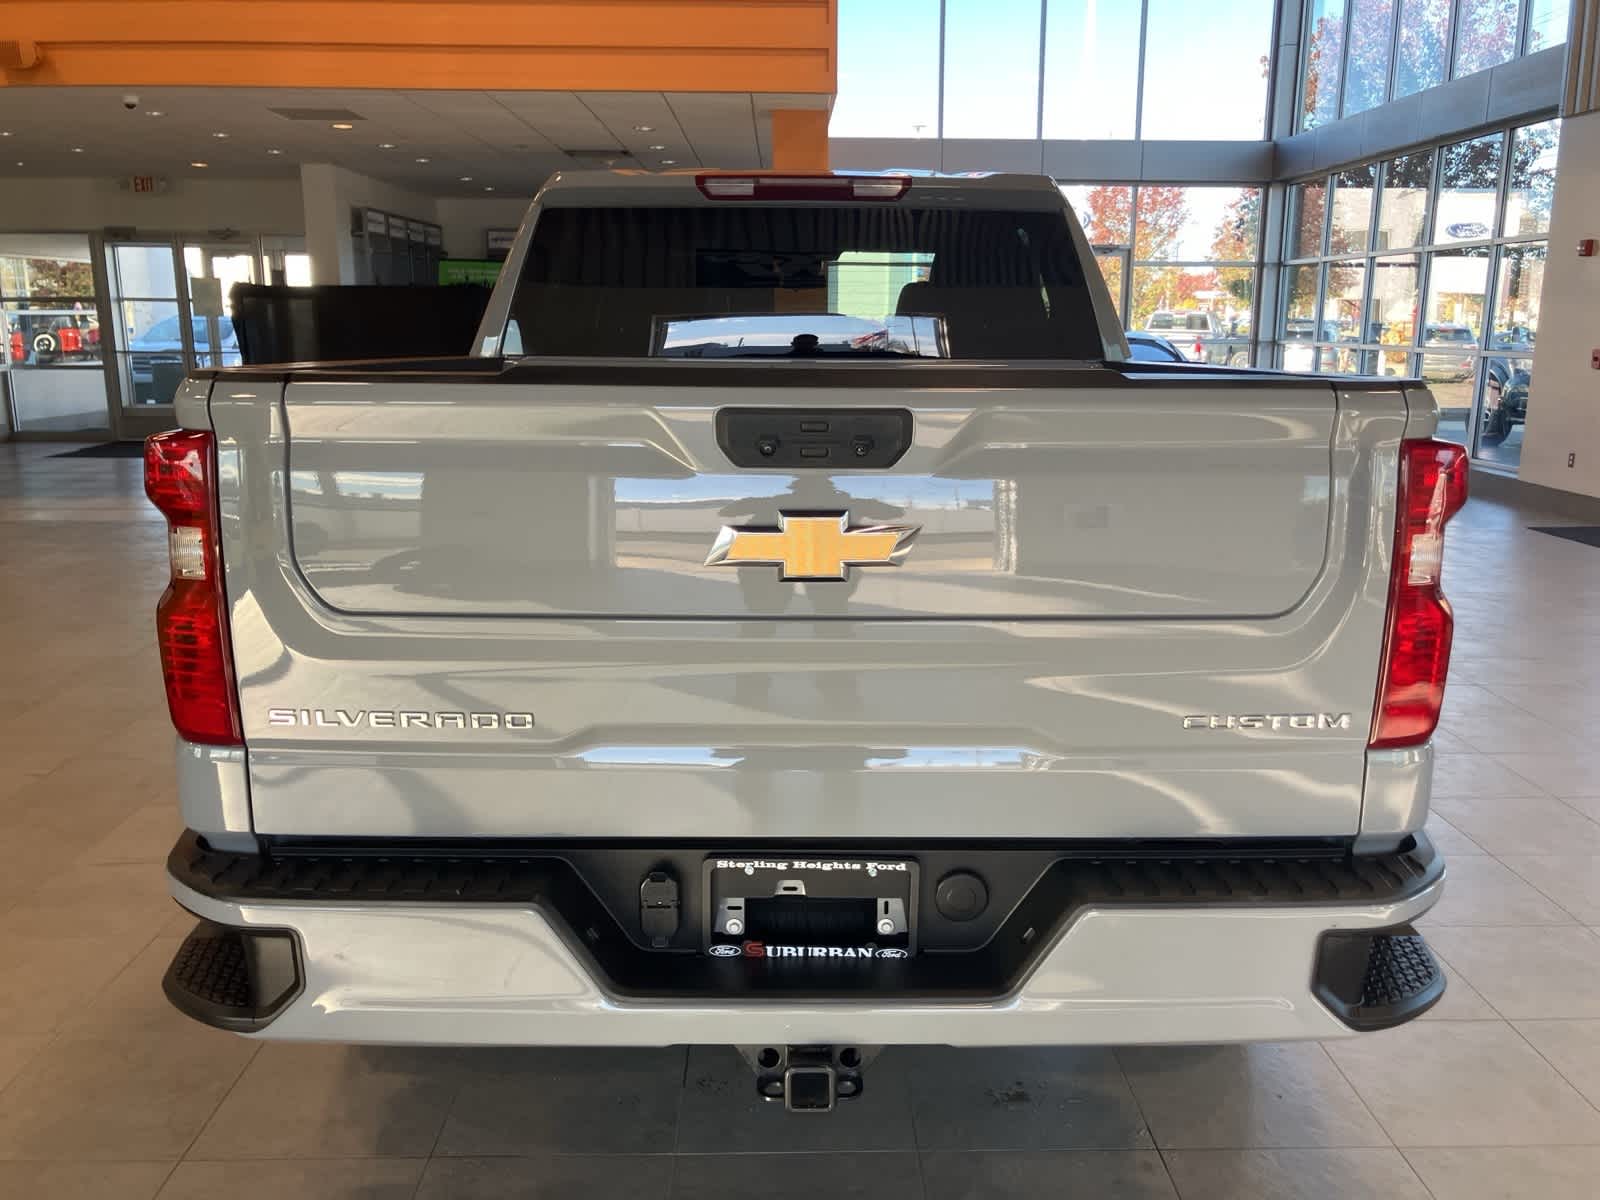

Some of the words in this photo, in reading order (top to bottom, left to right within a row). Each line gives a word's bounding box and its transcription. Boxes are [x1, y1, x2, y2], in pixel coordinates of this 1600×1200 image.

[135, 175, 154, 192] EXIT
[268, 708, 535, 729] SILVERADO
[1183, 713, 1351, 730] CUSTOM
[716, 860, 789, 870] Sterling
[792, 861, 861, 870] Heights
[865, 862, 906, 871] Ford
[712, 946, 738, 956] Ford
